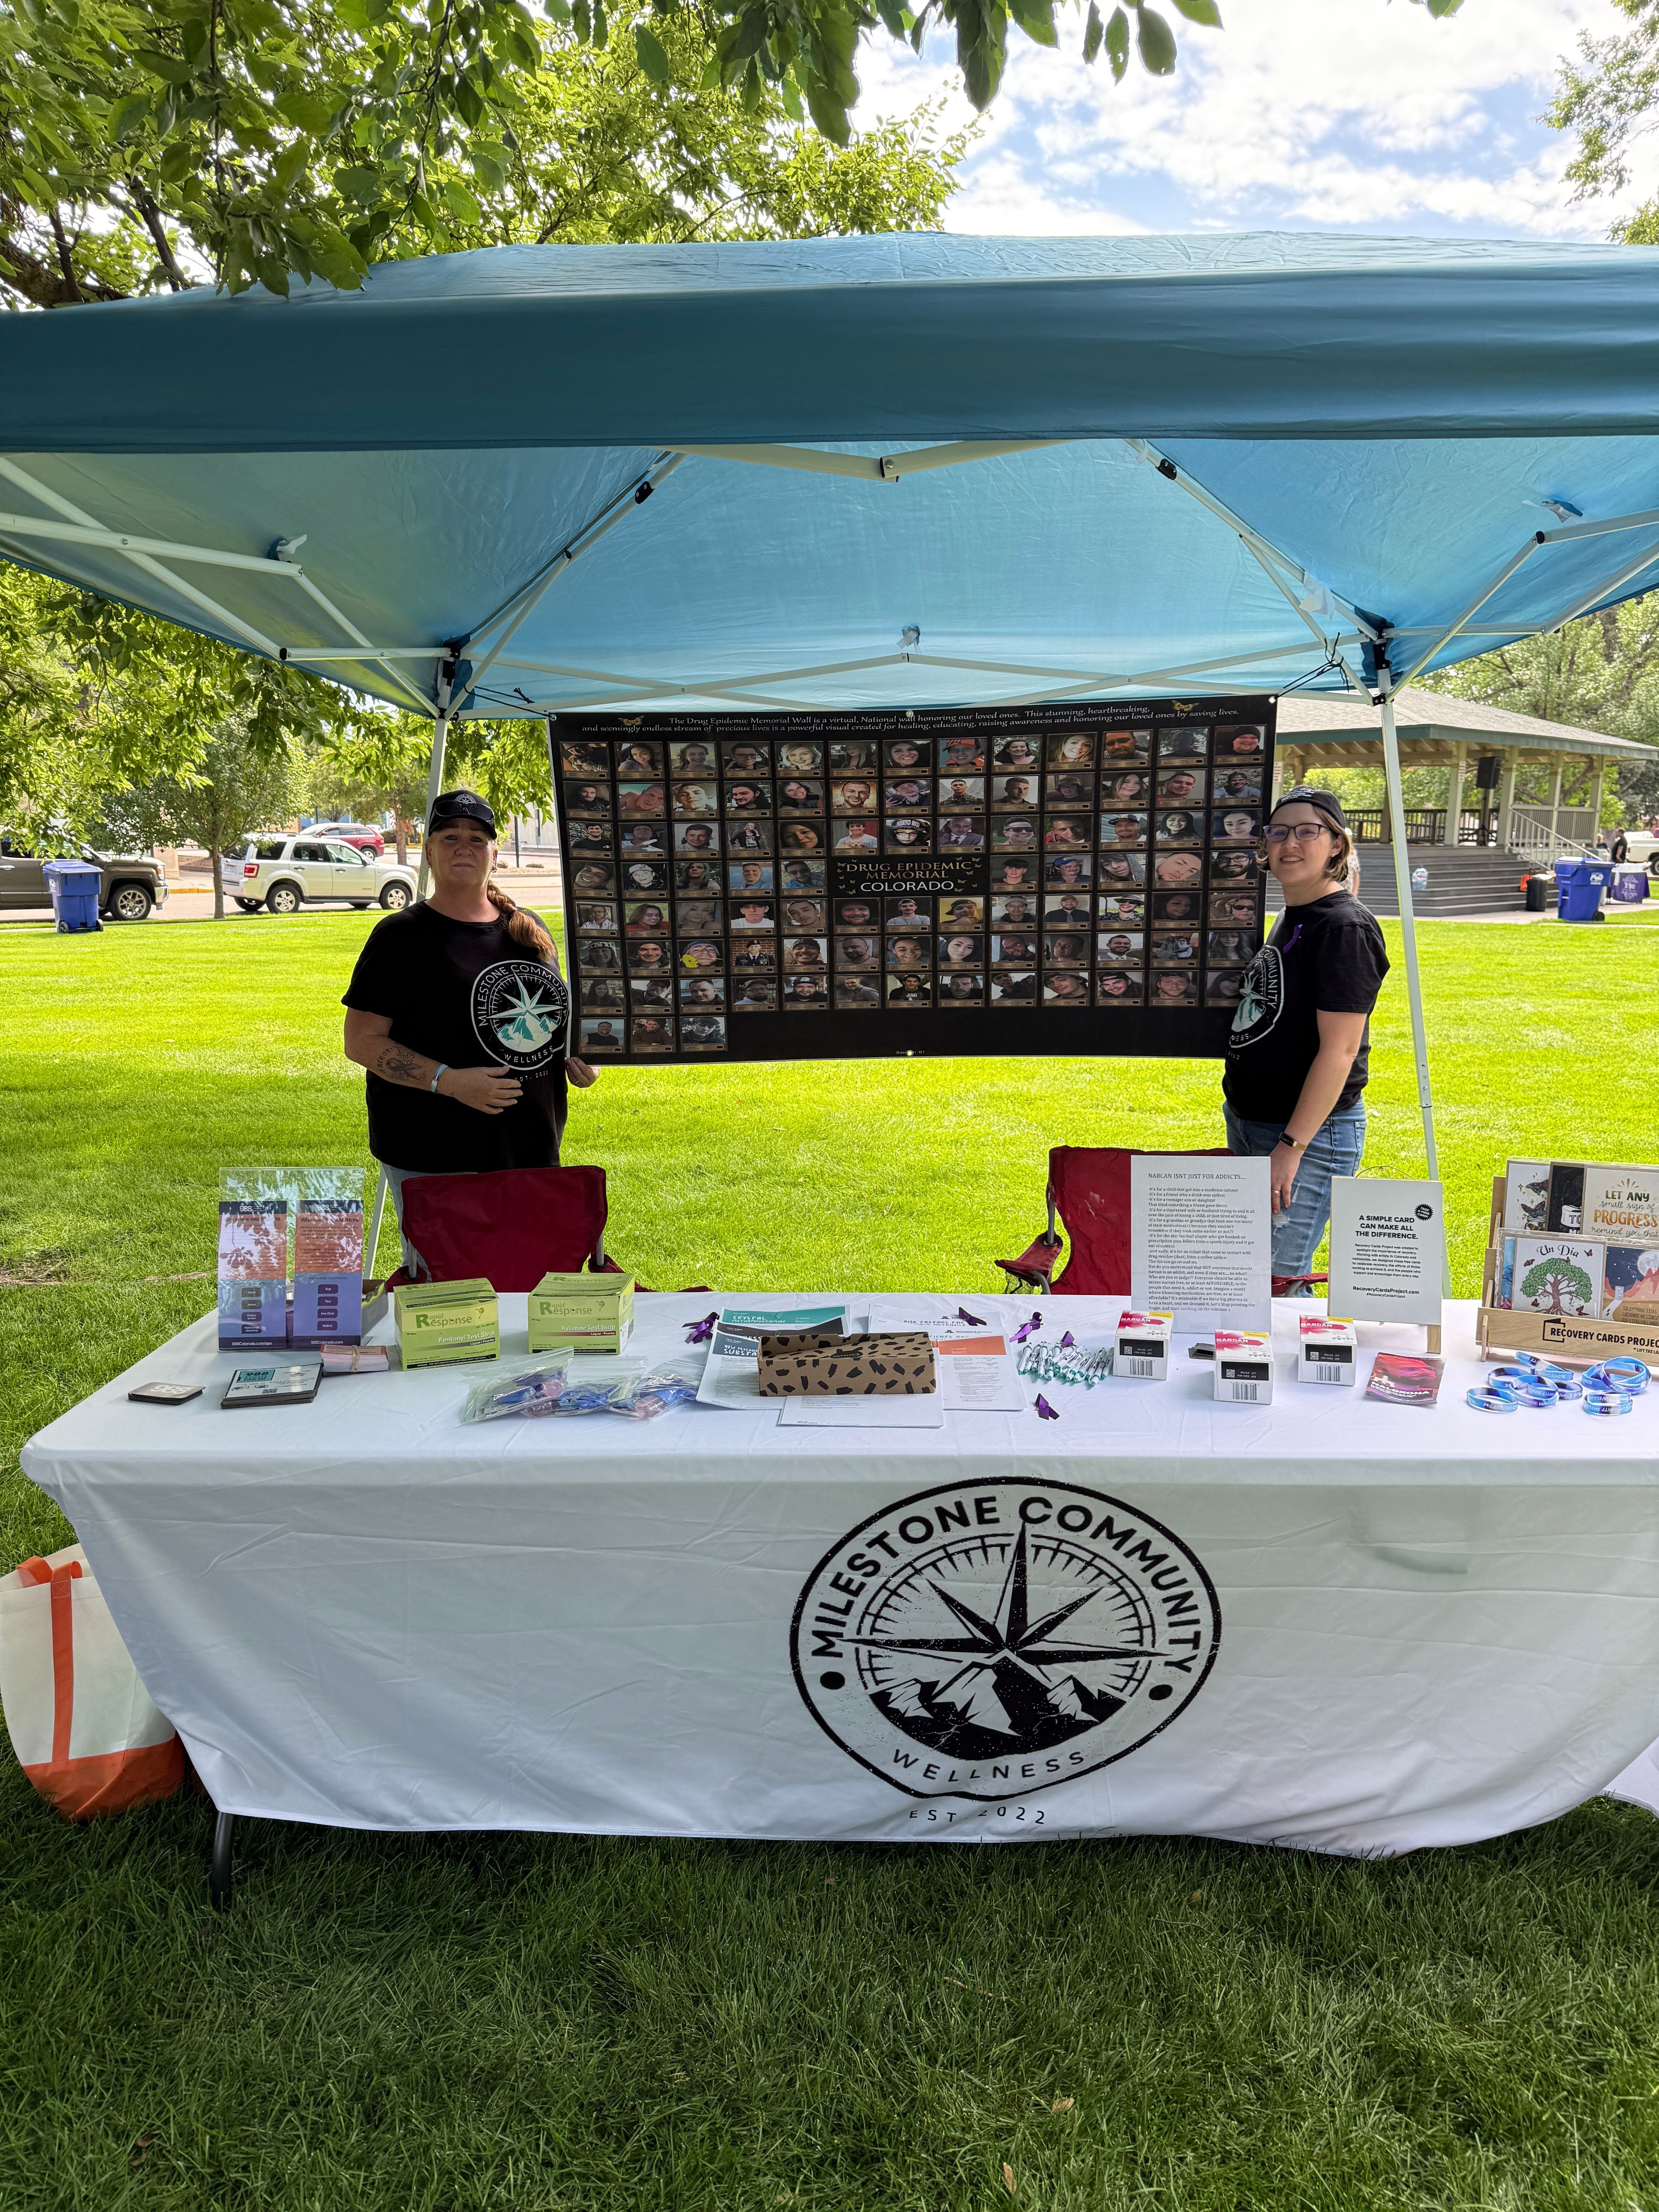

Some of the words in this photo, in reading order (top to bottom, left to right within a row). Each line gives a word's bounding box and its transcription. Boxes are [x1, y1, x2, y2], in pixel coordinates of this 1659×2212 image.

[601, 725, 640, 733] seemingly
[717, 725, 750, 733] precious
[788, 723, 823, 732] powerful
[882, 723, 896, 731] for
[898, 722, 931, 730] healing,
[1177, 711, 1187, 719] by
[711, 717, 748, 725] Epidemic
[898, 862, 971, 871] EPIDEMIC
[866, 871, 948, 879] MEMORIAL
[860, 881, 954, 891] COLORADO
[478, 967, 509, 1026] MILESTONE
[510, 965, 567, 1016] COMMUNITY
[505, 1046, 553, 1063] WELLNESS
[1606, 1190, 1623, 1199] LET
[1627, 1192, 1649, 1202] ANY
[1626, 1203, 1644, 1211] sign
[1647, 1204, 1655, 1213] of
[1594, 1209, 1658, 1228] PROGRESS
[1592, 1227, 1623, 1235] remind
[1537, 1245, 1554, 1255] Un
[1353, 1286, 1419, 1294] RecoveryCardsProject.com
[438, 1335, 466, 1344] Fentanyl
[481, 1330, 495, 1338] Strip
[1551, 1328, 1594, 1340] RECOVERY
[1597, 1333, 1625, 1344] CARDS
[1627, 1336, 1659, 1348] PROJEC
[1371, 1381, 1430, 1395] NALOXONA
[812, 1496, 1001, 1657] MILESTONE
[1019, 1496, 1202, 1674] COMMUNITY
[893, 1749, 1084, 1783] WELLNESS
[978, 1806, 1044, 1824] 2022
